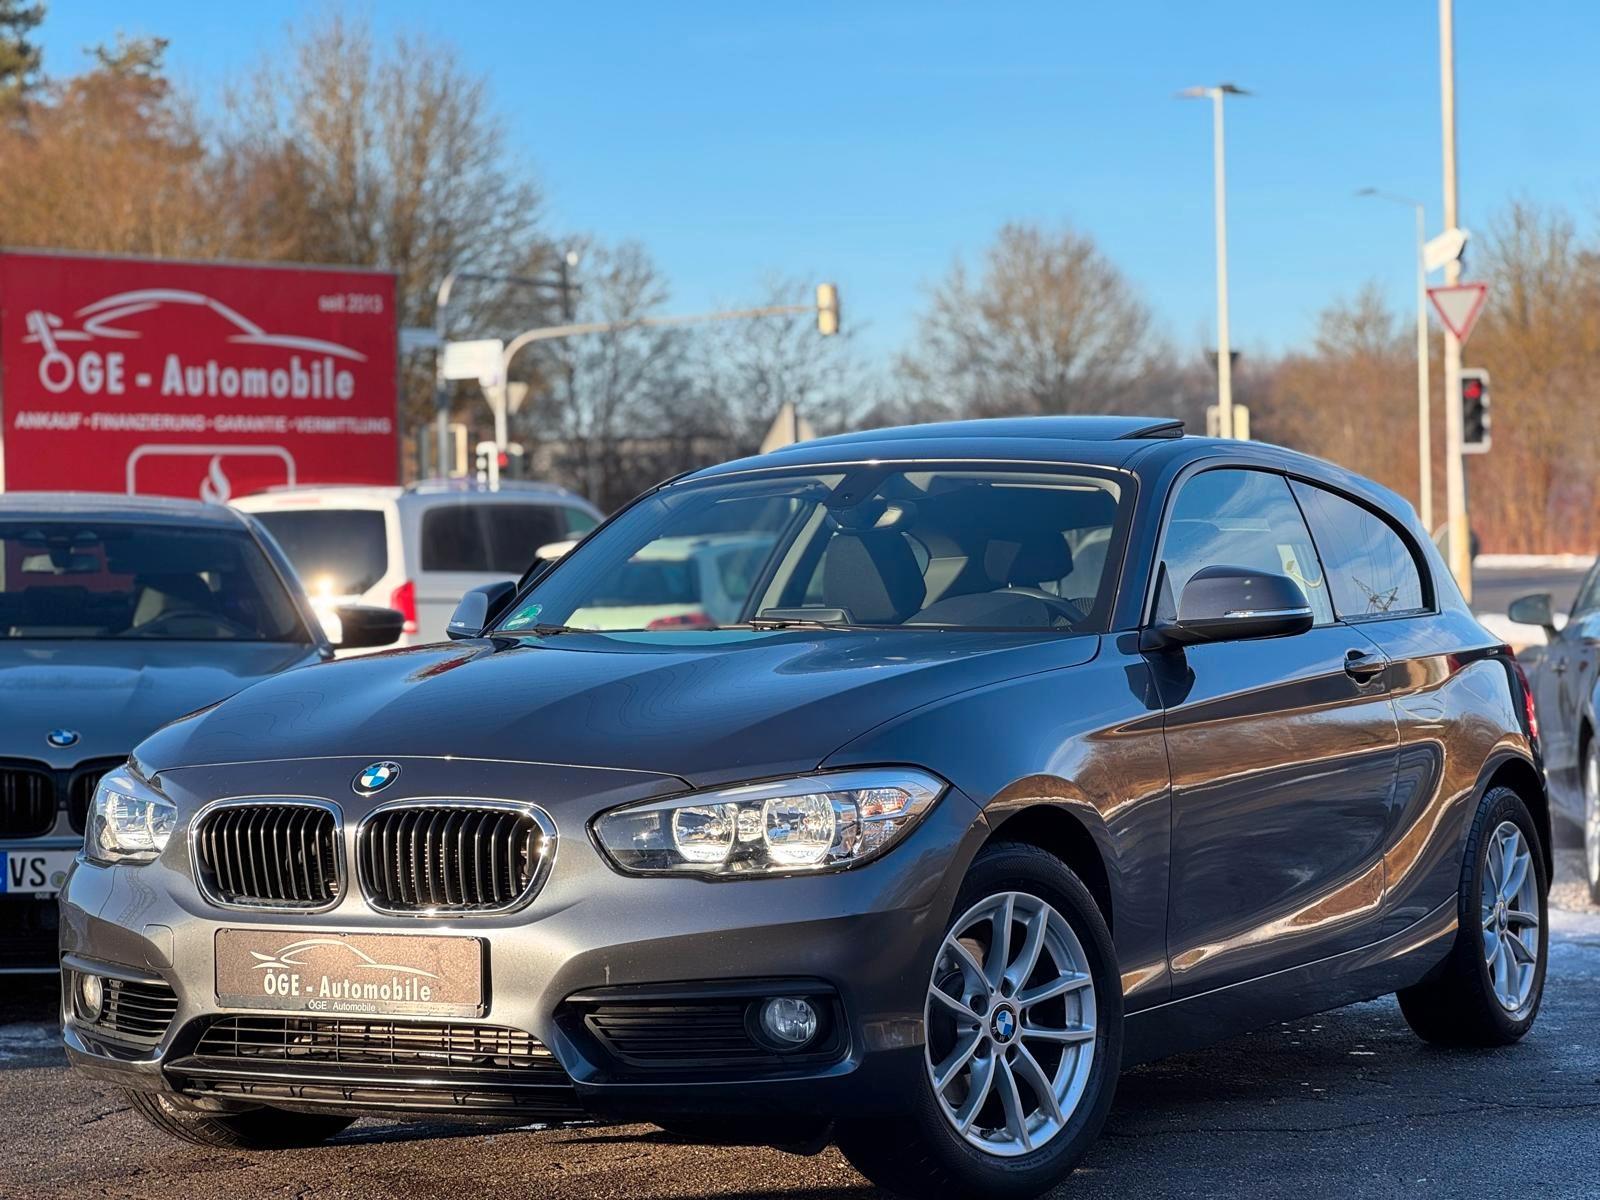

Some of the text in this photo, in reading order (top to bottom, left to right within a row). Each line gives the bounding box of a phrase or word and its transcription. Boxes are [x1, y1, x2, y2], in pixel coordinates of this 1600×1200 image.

[161, 352, 355, 400] Automobile
[15, 411, 391, 435] ANKAUF FINANZIERUNG GARANTIE VERMITTLUNG
[263, 968, 299, 996] ÖGE
[319, 975, 431, 1002] Automobile
[308, 998, 376, 1012] ÖGE Automobile
